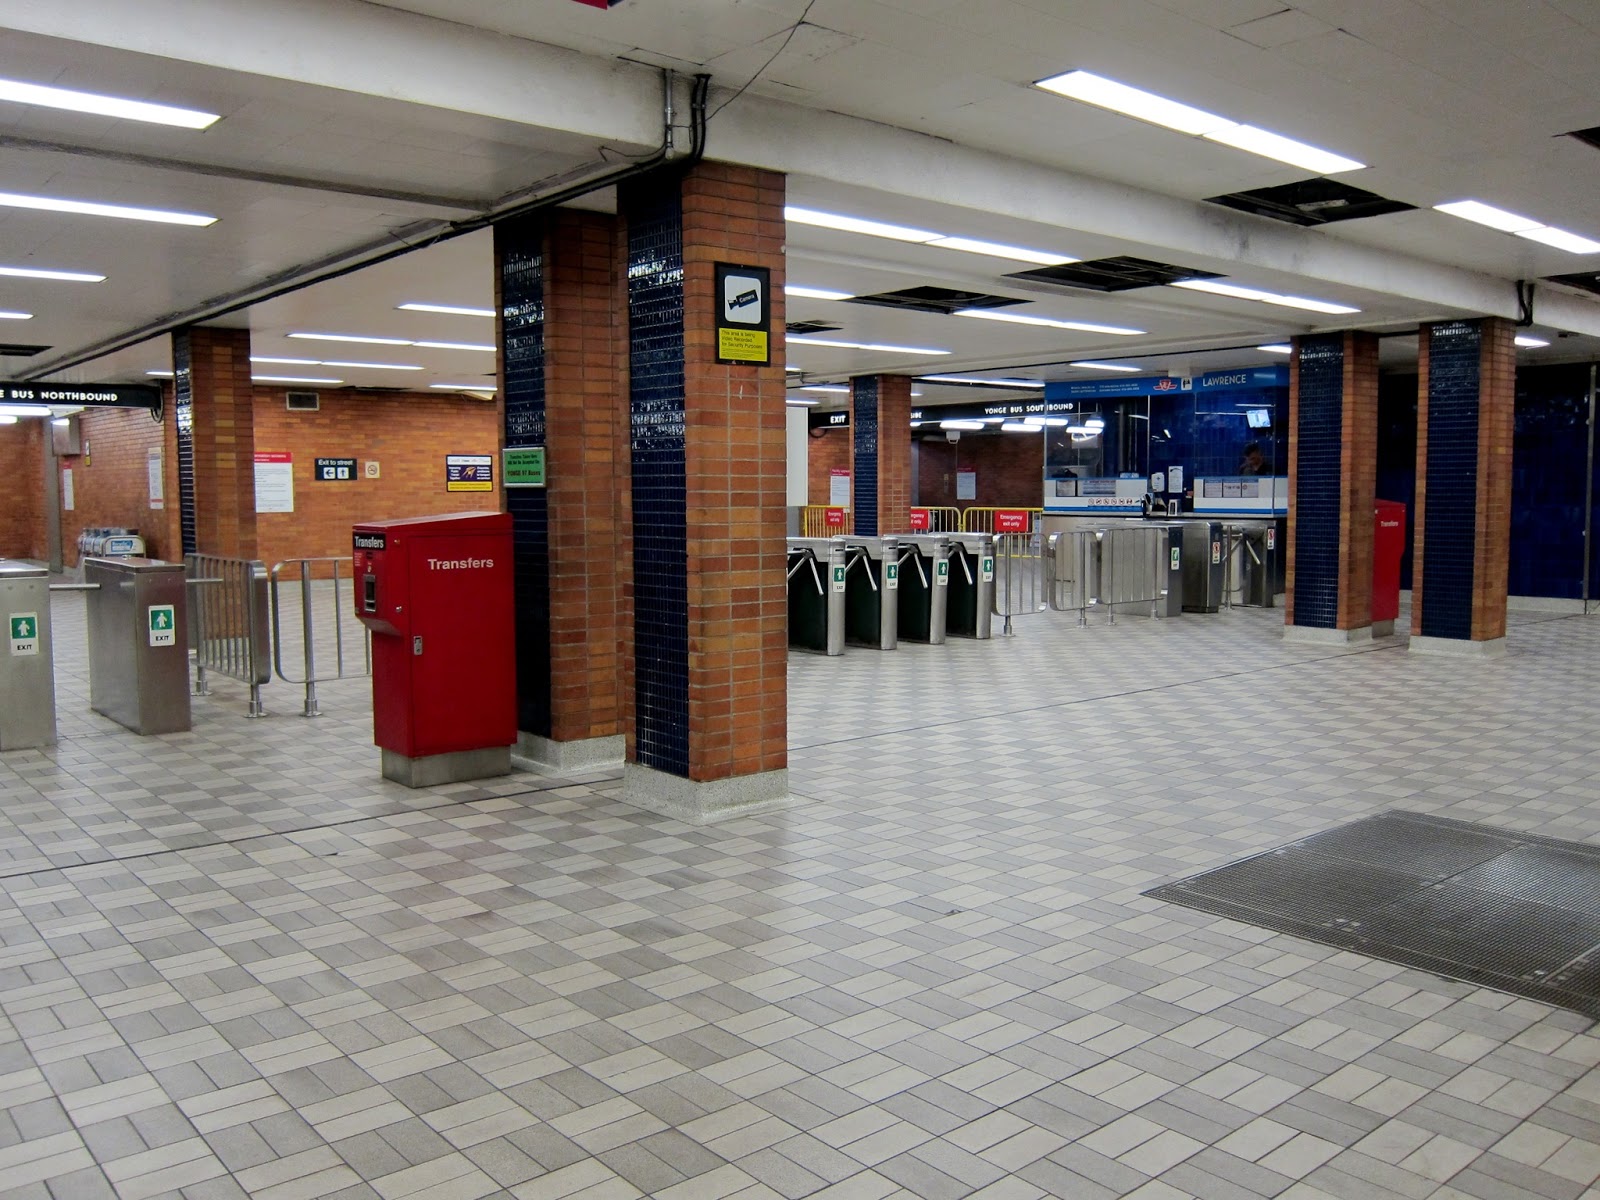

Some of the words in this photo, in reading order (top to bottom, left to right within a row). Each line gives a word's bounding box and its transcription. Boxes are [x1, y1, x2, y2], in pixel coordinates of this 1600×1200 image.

[1203, 374, 1246, 387] LAWRENCE
[11, 390, 34, 399] BUS
[41, 391, 118, 402] NORTHBOUND
[984, 406, 1007, 415] YONGE
[830, 415, 846, 424] EXIT
[354, 536, 384, 549] Transfers
[428, 557, 494, 570] Transfers
